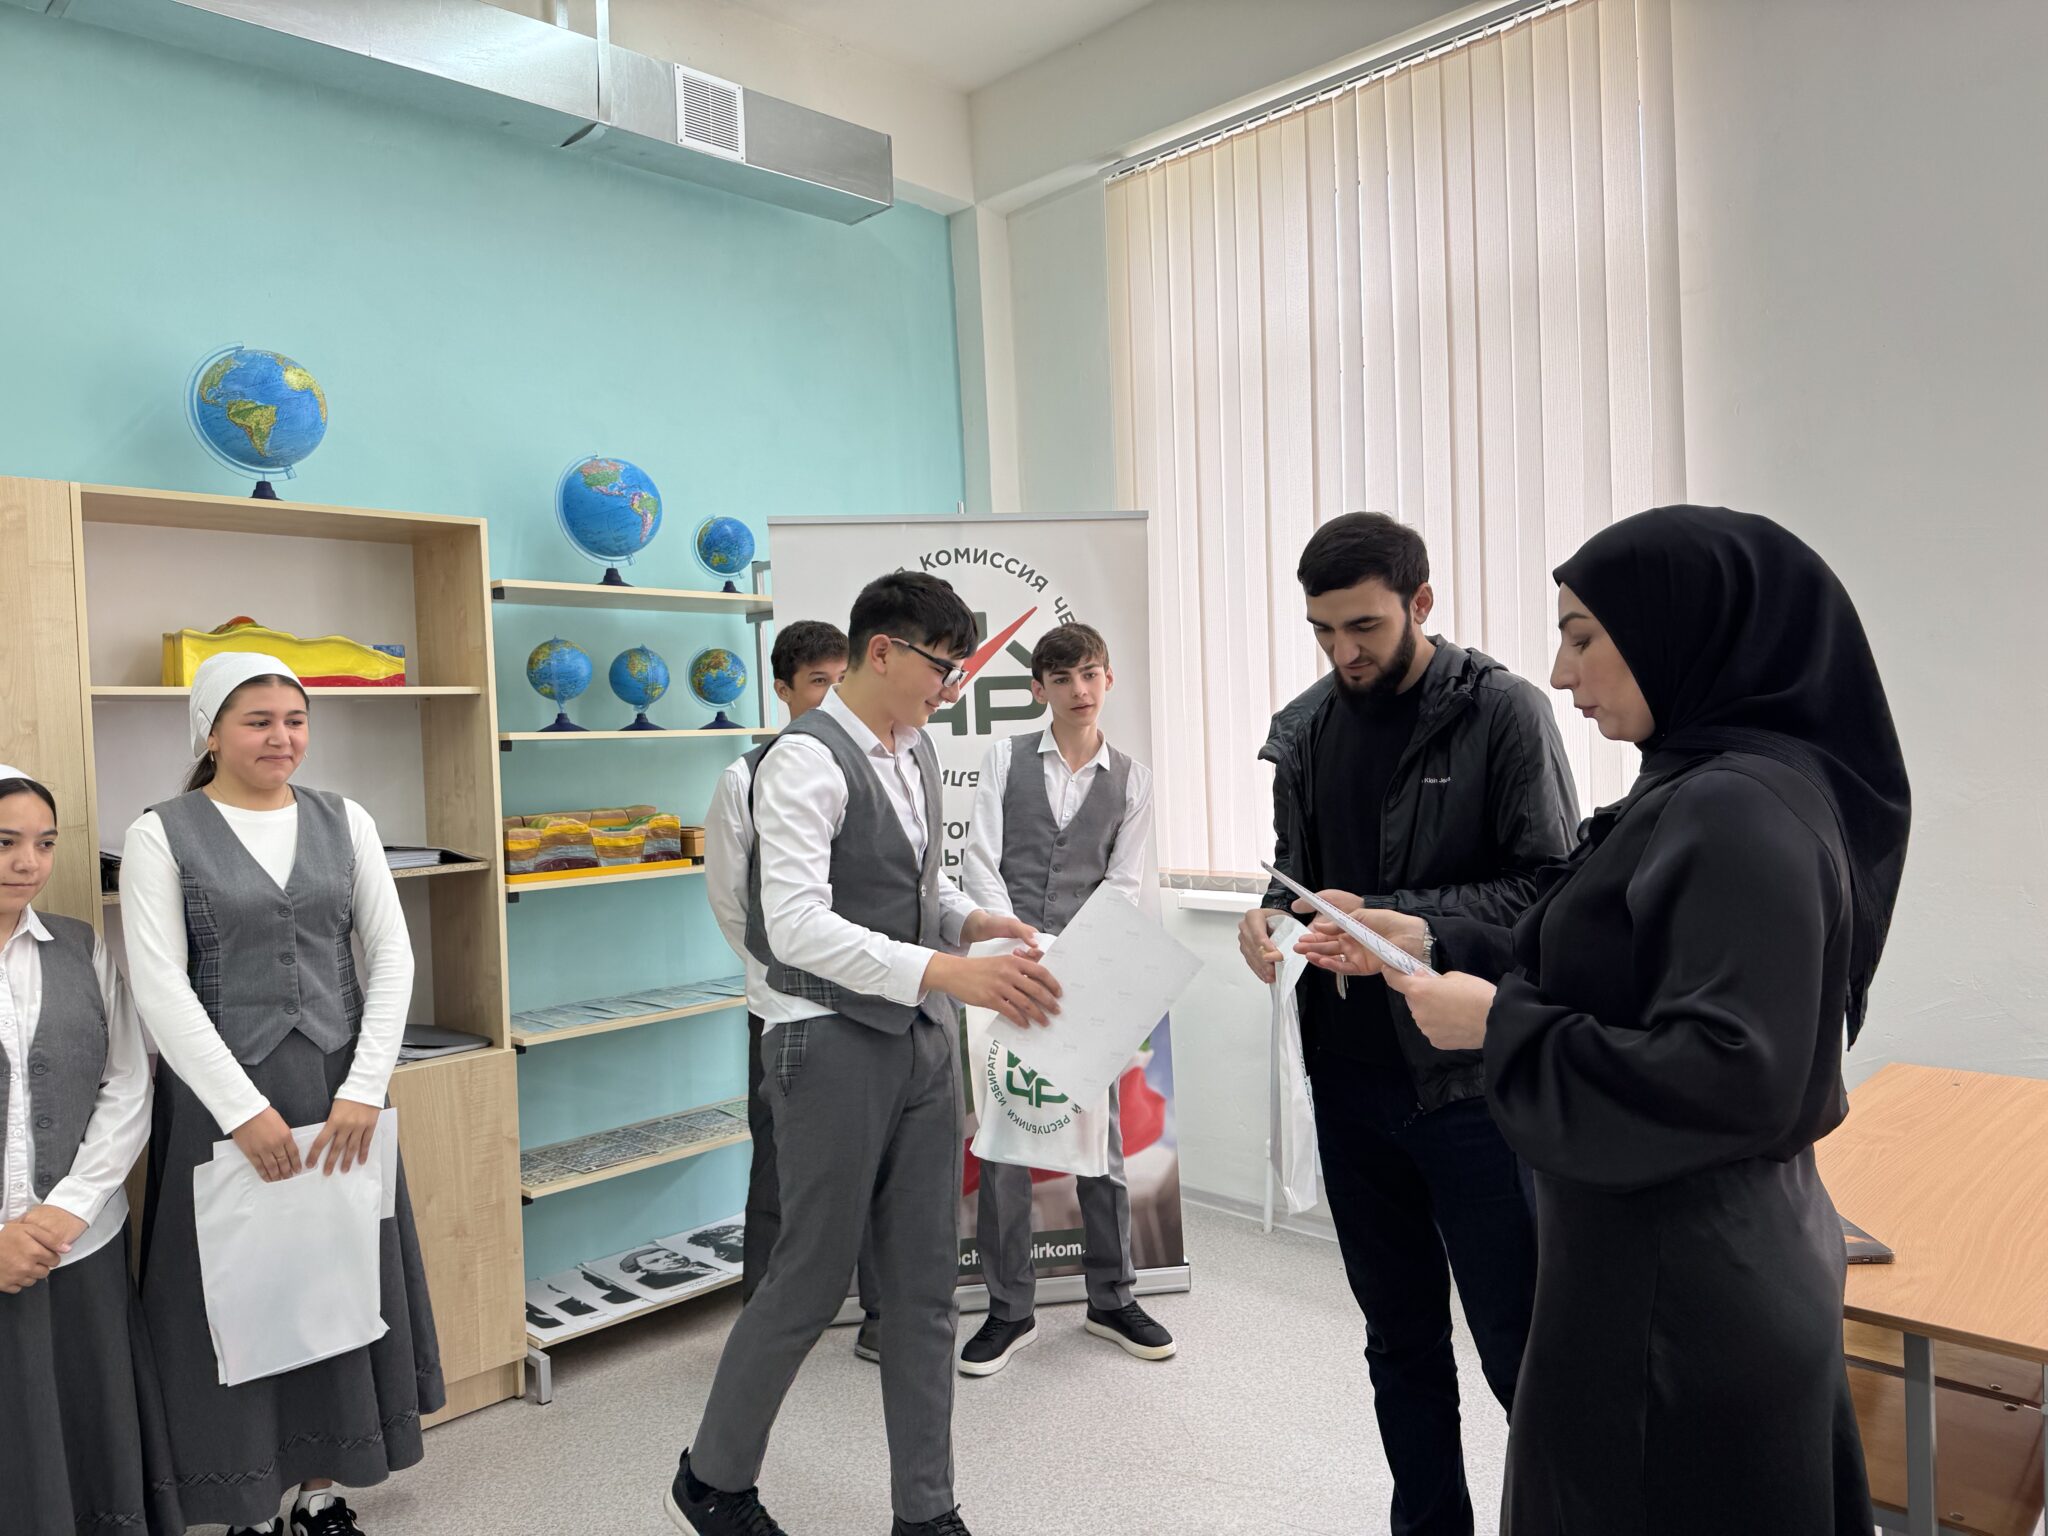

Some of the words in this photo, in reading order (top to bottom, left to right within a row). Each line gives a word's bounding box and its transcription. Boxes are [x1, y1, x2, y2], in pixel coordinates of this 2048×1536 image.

[919, 547, 1049, 593] КОМИССИЯ
[1054, 596, 1076, 625] ЧЕ
[987, 1039, 1007, 1107] ИЗБИРАТЕЛ
[1007, 1108, 1071, 1135] РЕСПУБЛИКИ
